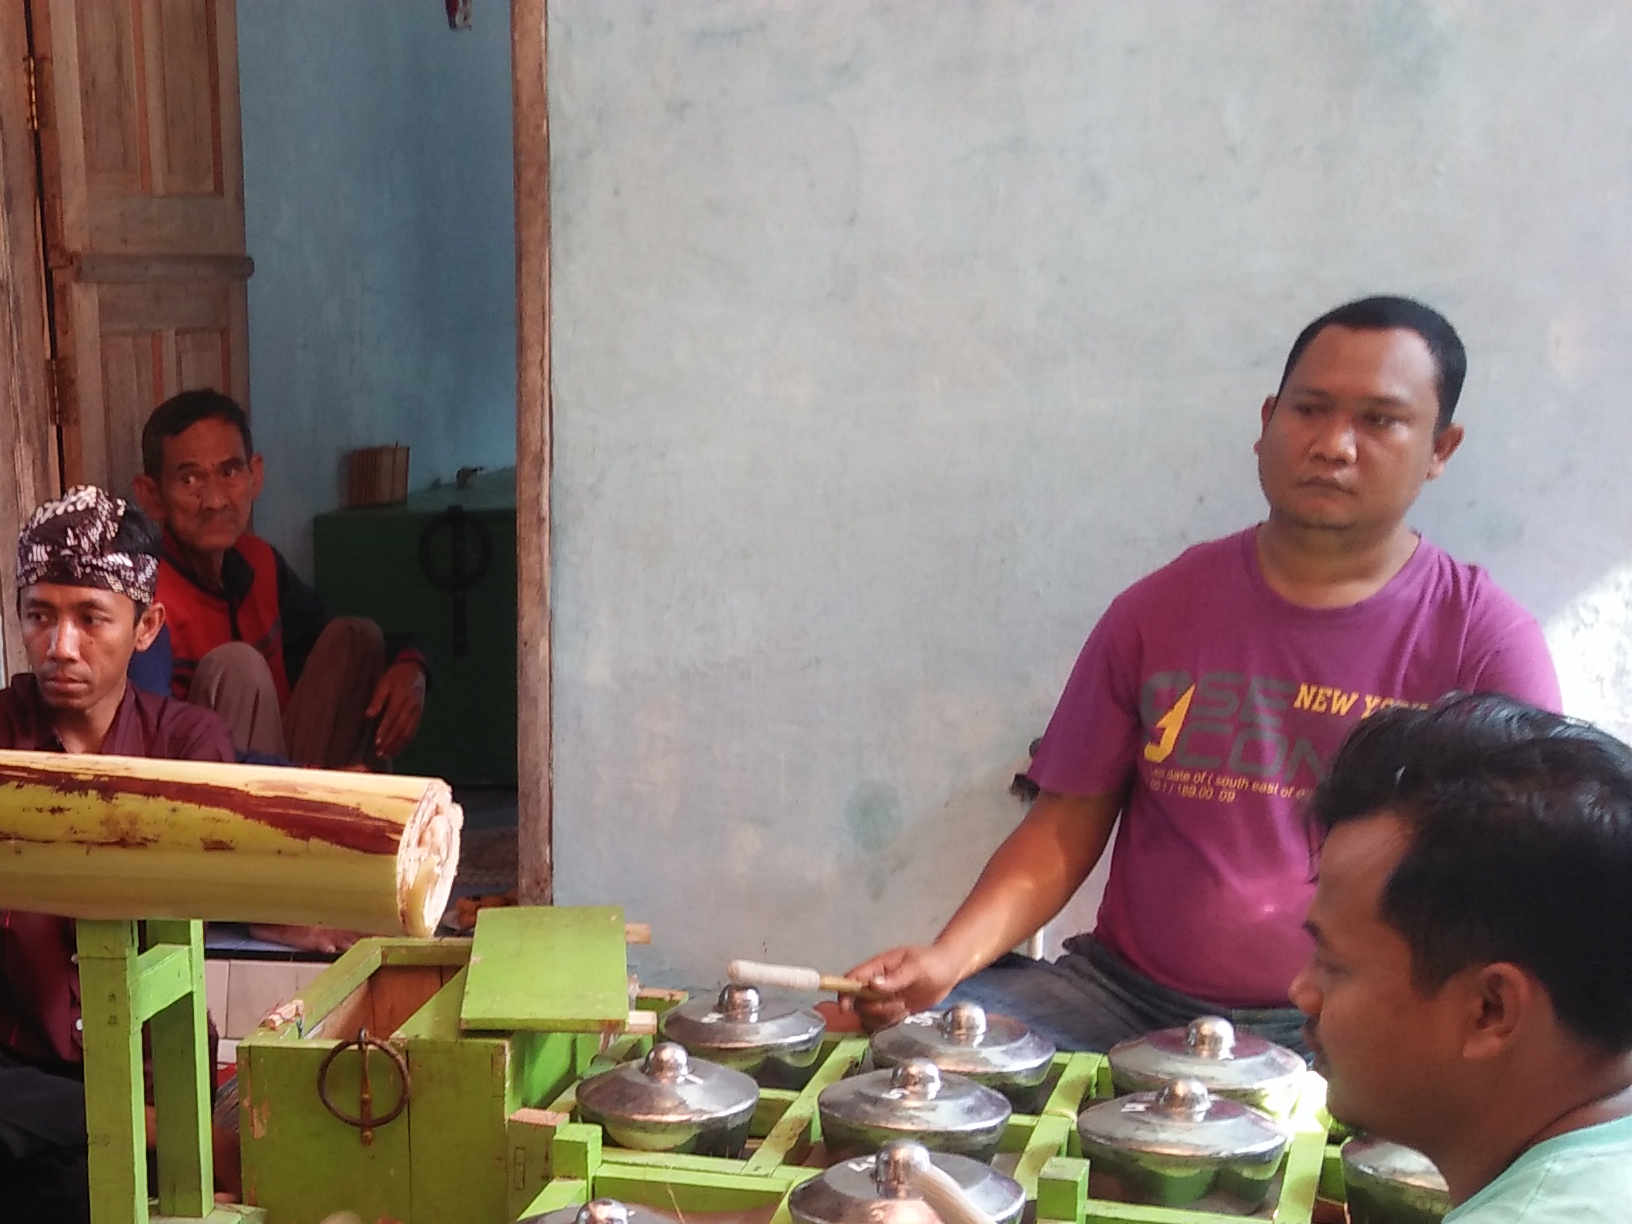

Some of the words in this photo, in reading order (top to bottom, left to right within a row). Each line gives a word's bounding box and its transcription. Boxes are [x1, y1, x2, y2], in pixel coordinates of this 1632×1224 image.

[1293, 682, 1360, 717] NEW
[1216, 775, 1250, 790] south
[1252, 782, 1279, 795] east
